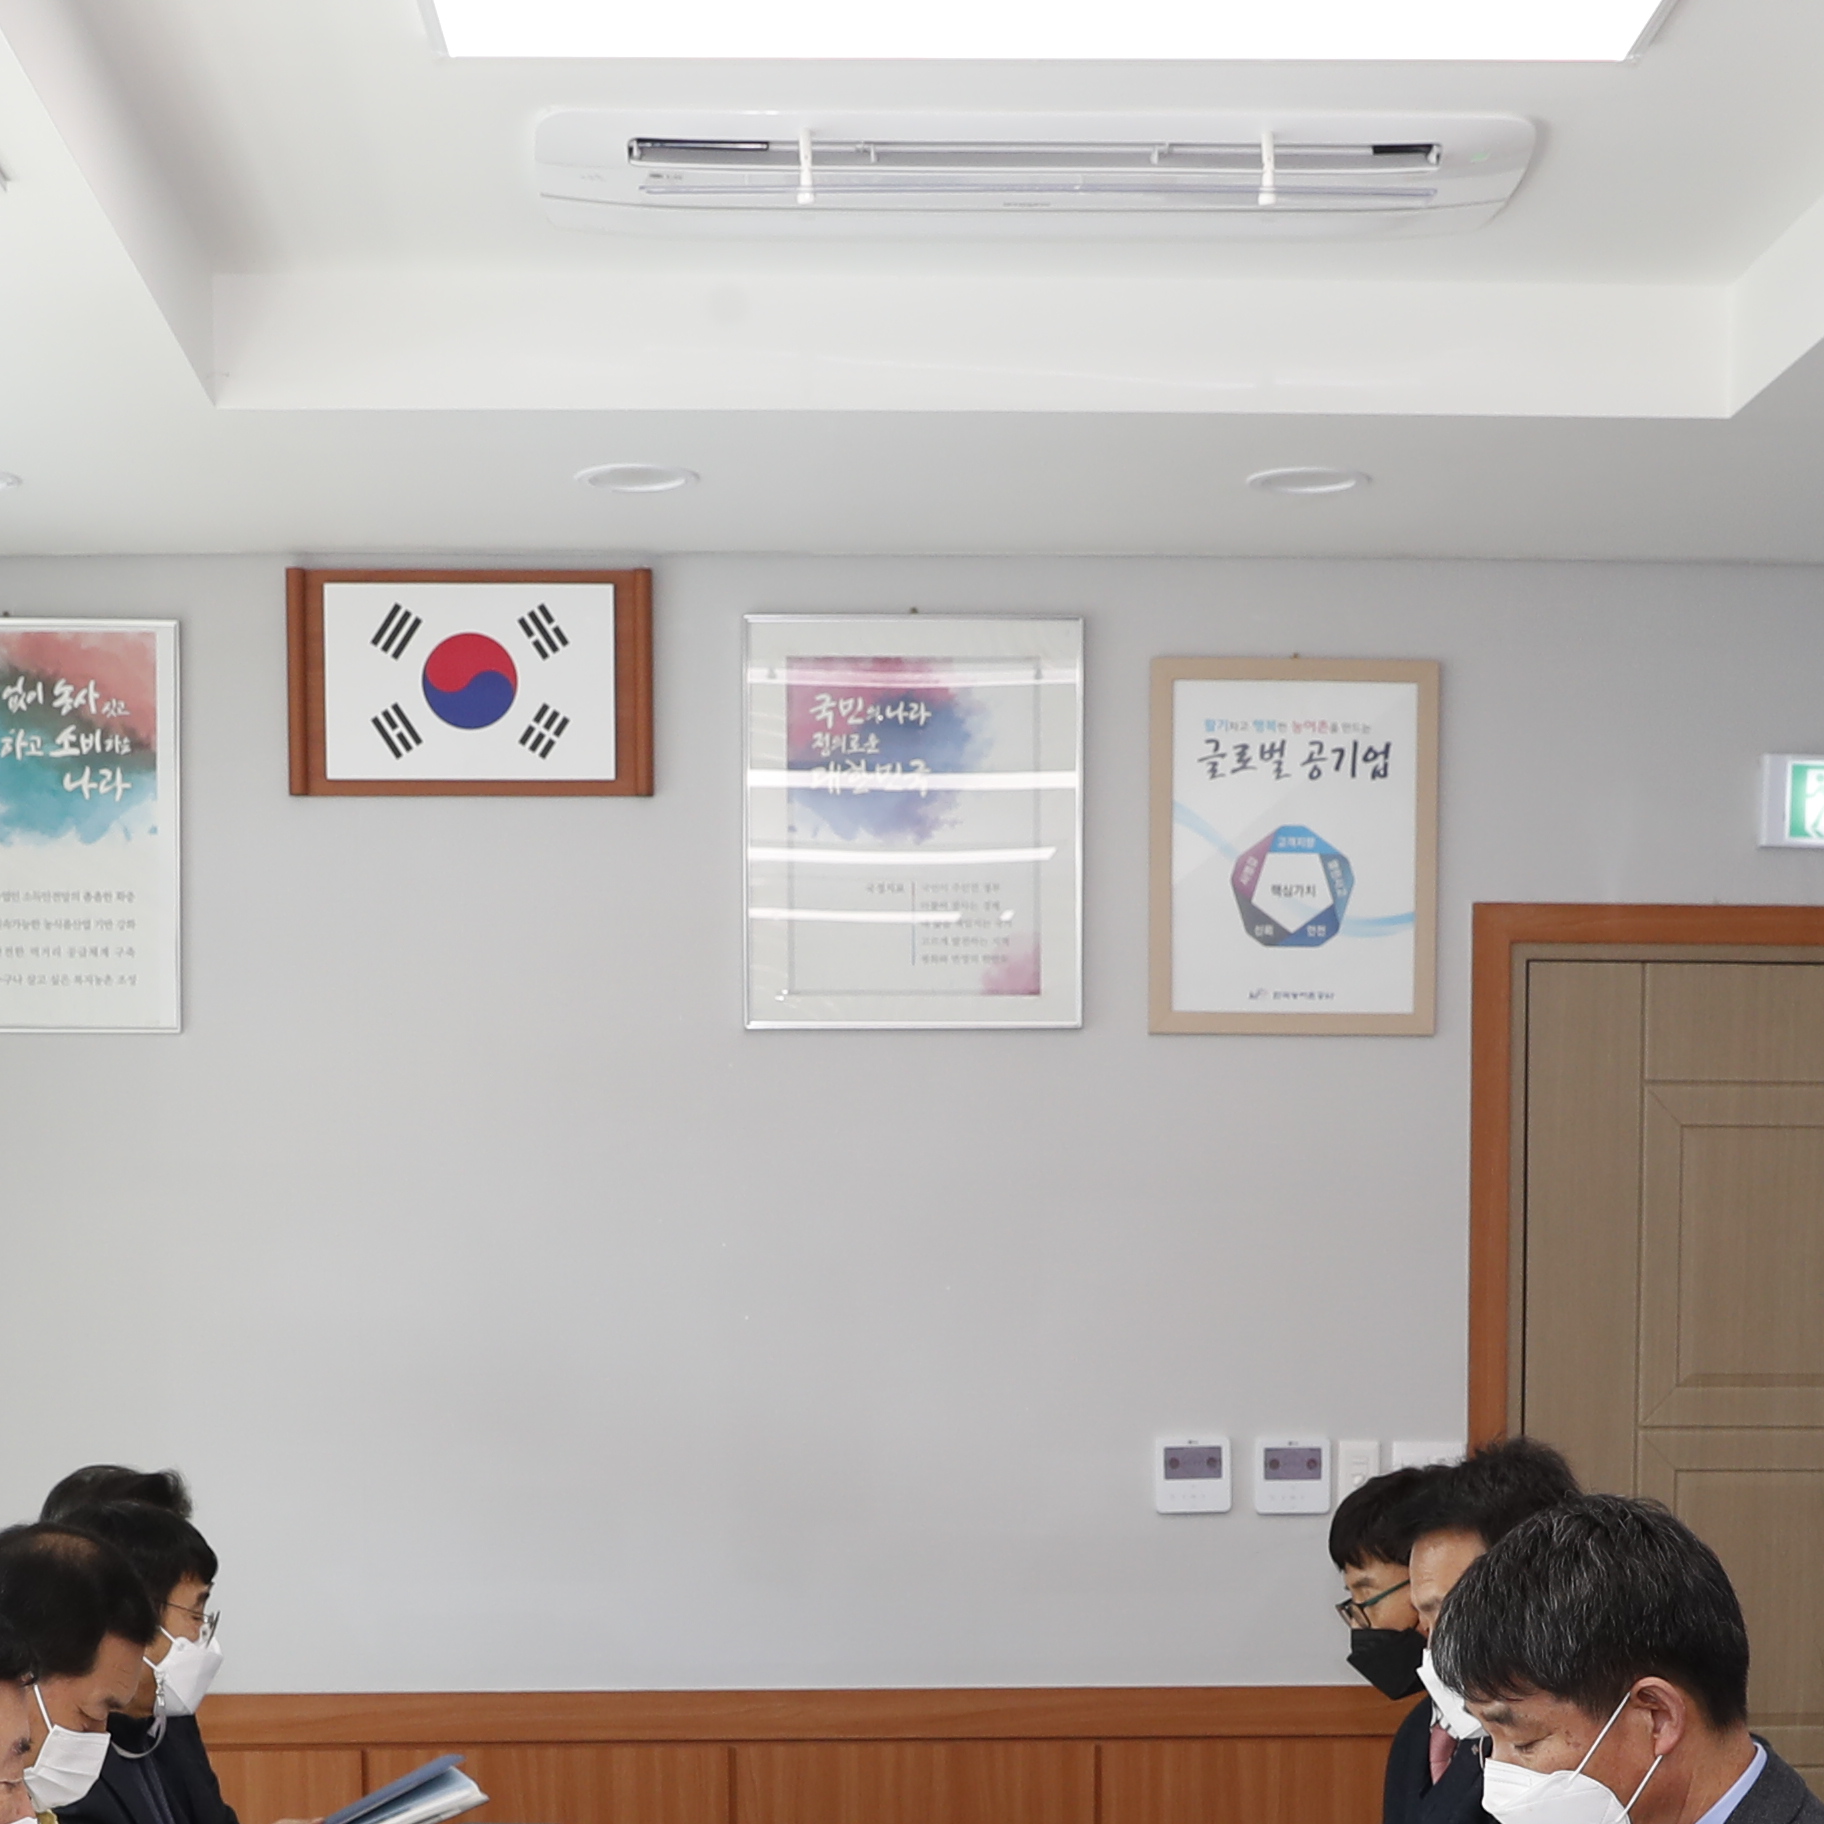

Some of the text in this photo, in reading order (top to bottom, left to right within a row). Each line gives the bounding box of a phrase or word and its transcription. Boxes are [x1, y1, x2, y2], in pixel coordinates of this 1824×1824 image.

[2, 675, 44, 714] 없이
[884, 699, 933, 728] 나라
[810, 729, 880, 759] 정의로운
[1196, 737, 1393, 781] 글로벌 공기업
[62, 765, 132, 802] 나라
